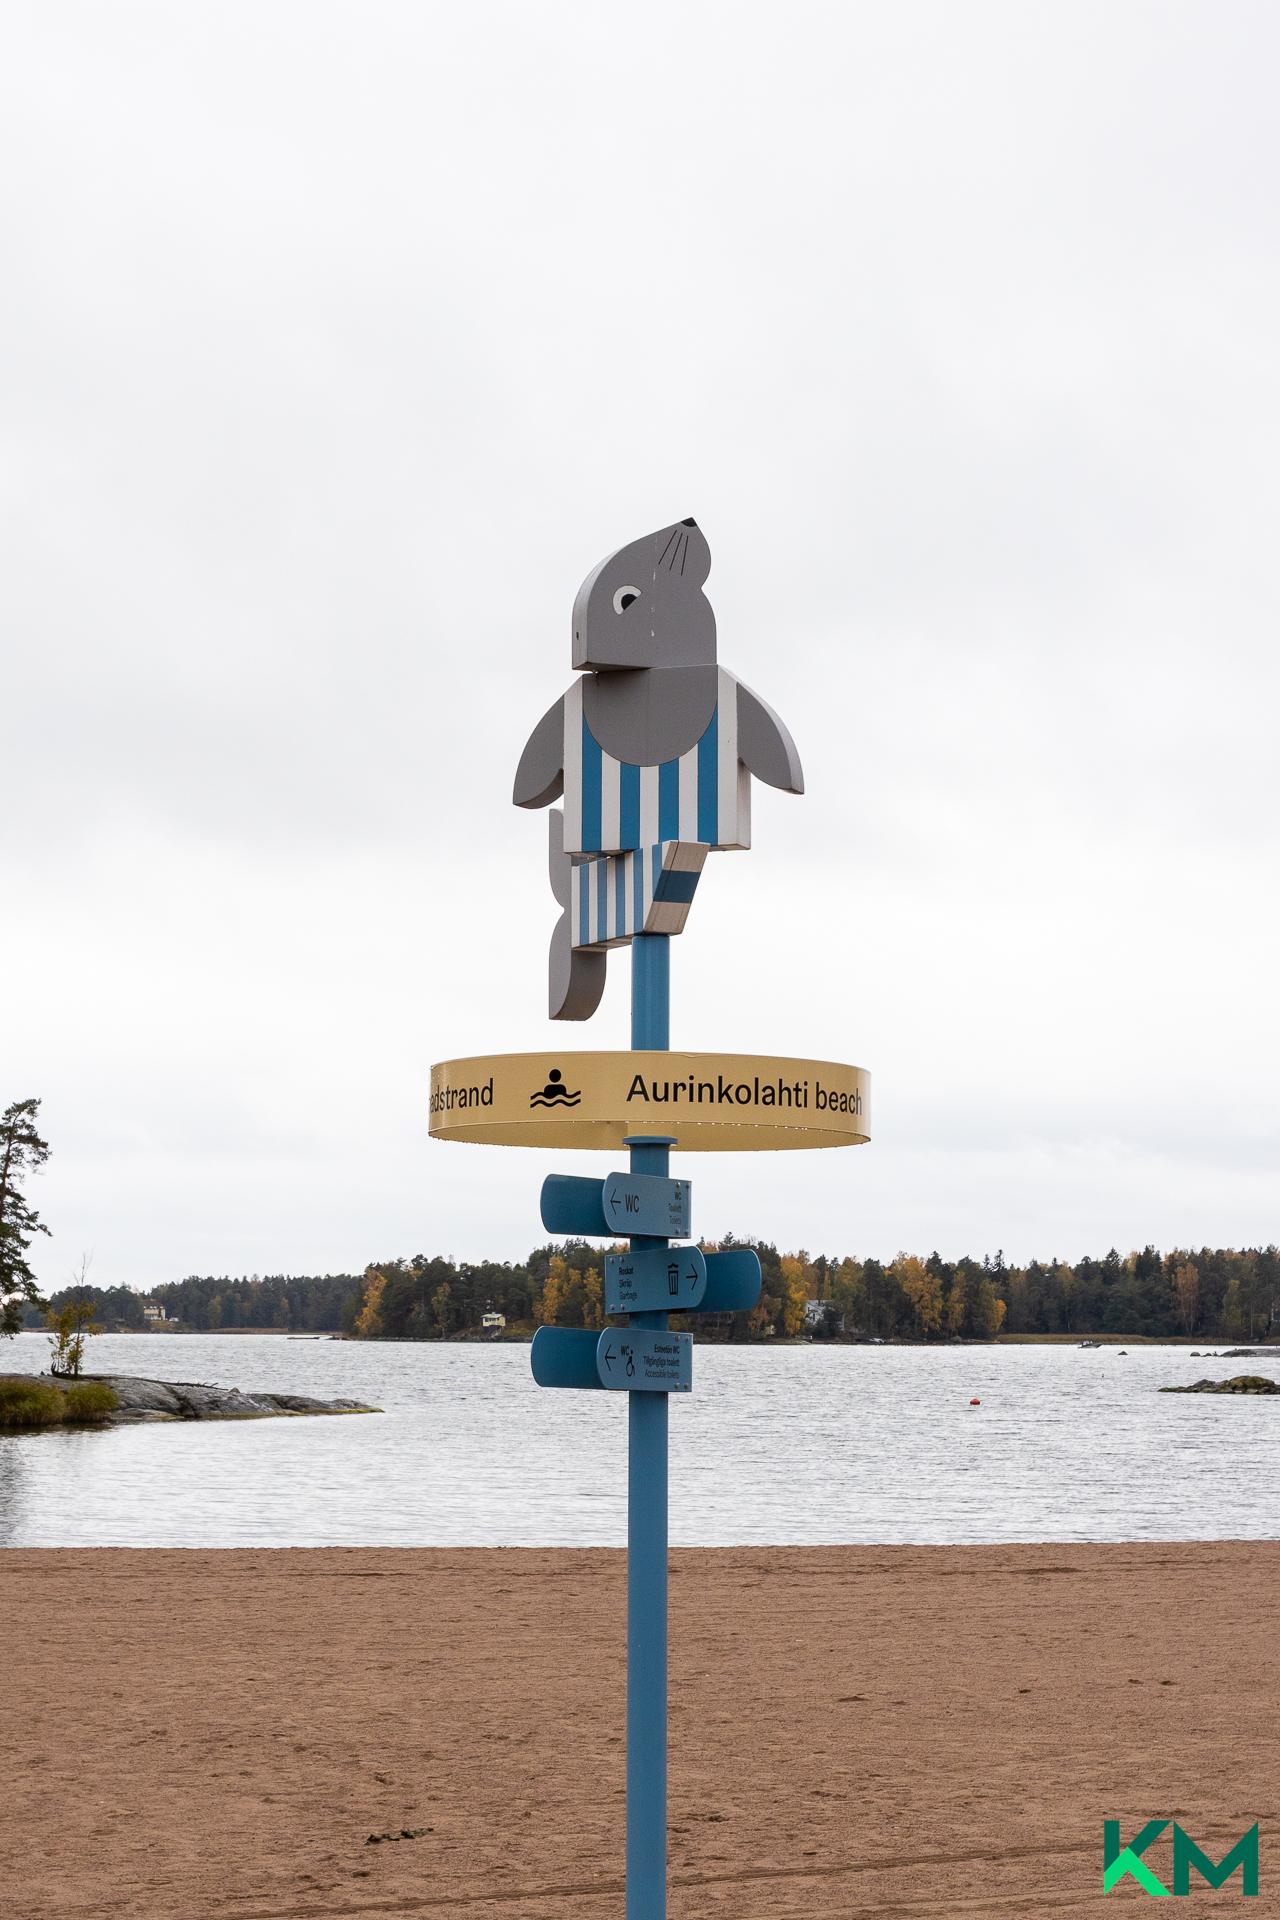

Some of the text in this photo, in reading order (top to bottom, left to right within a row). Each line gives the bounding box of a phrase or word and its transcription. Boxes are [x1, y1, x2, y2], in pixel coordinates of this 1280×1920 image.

[626, 1074, 863, 1116] Aurinkolahti beach
[624, 1193, 640, 1213] WC
[620, 1344, 630, 1356] WC
